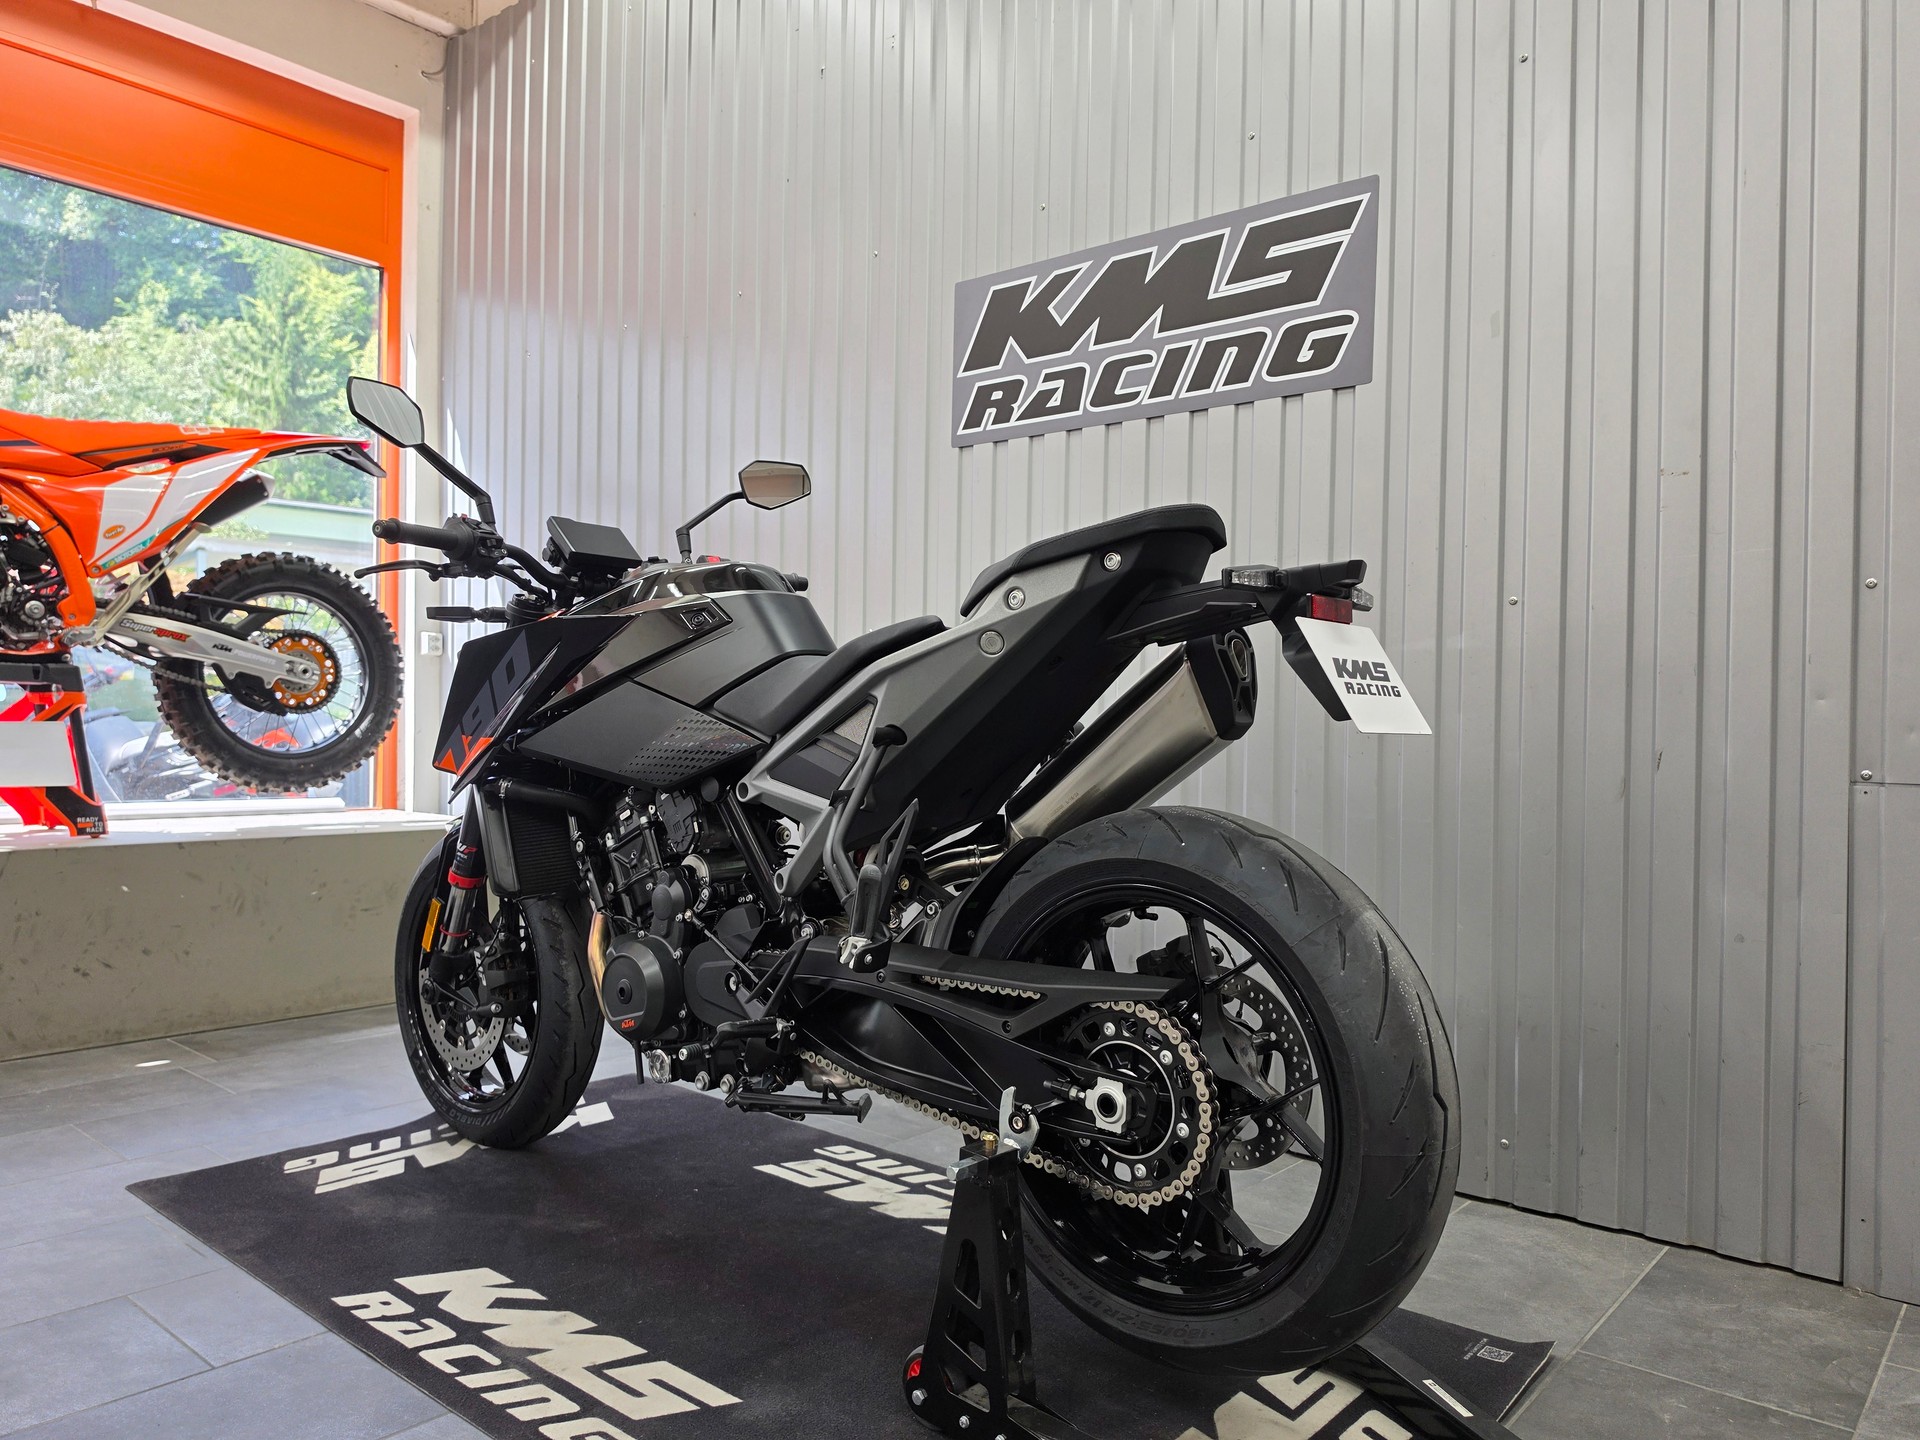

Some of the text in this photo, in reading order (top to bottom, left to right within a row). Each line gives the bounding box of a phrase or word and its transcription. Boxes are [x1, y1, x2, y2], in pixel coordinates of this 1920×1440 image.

[957, 193, 1370, 377] KMS
[957, 310, 1359, 435] RACING
[212, 643, 232, 653] KTM
[1332, 657, 1391, 683] KMS
[433, 629, 531, 774] 790
[1344, 681, 1402, 698] RACING
[621, 1018, 636, 1029] KTM
[448, 1108, 483, 1126] DIABLO
[394, 1267, 744, 1421] KMS
